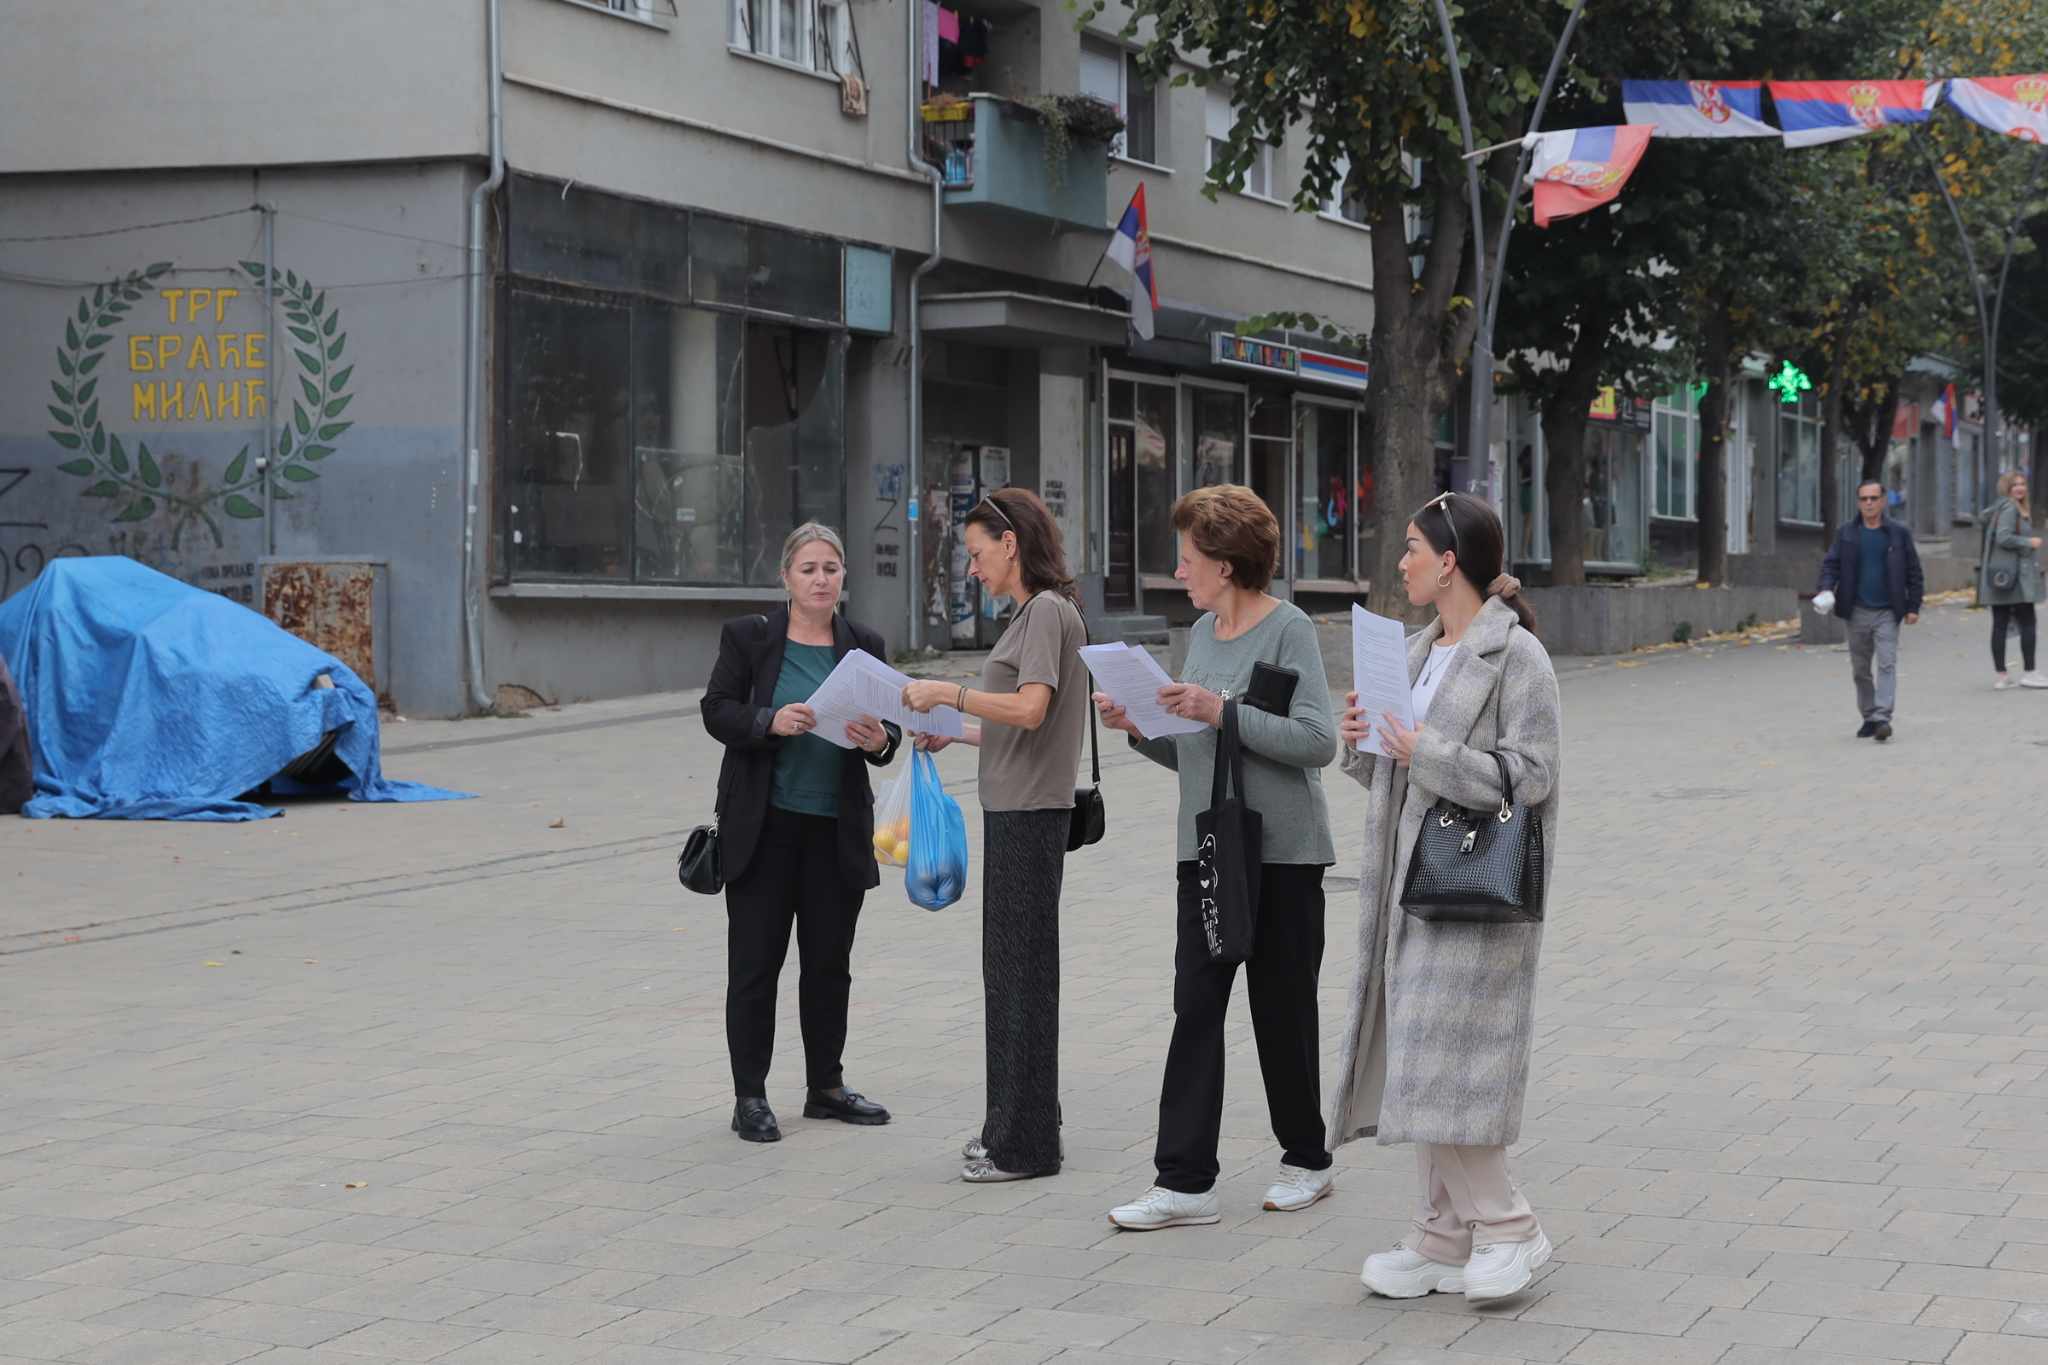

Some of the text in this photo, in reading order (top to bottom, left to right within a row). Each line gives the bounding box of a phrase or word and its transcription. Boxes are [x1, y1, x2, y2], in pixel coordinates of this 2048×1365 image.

[160, 288, 240, 324] ТРГ
[128, 333, 267, 371] БРАЋЕ
[132, 379, 267, 422] МИЛИЋ
